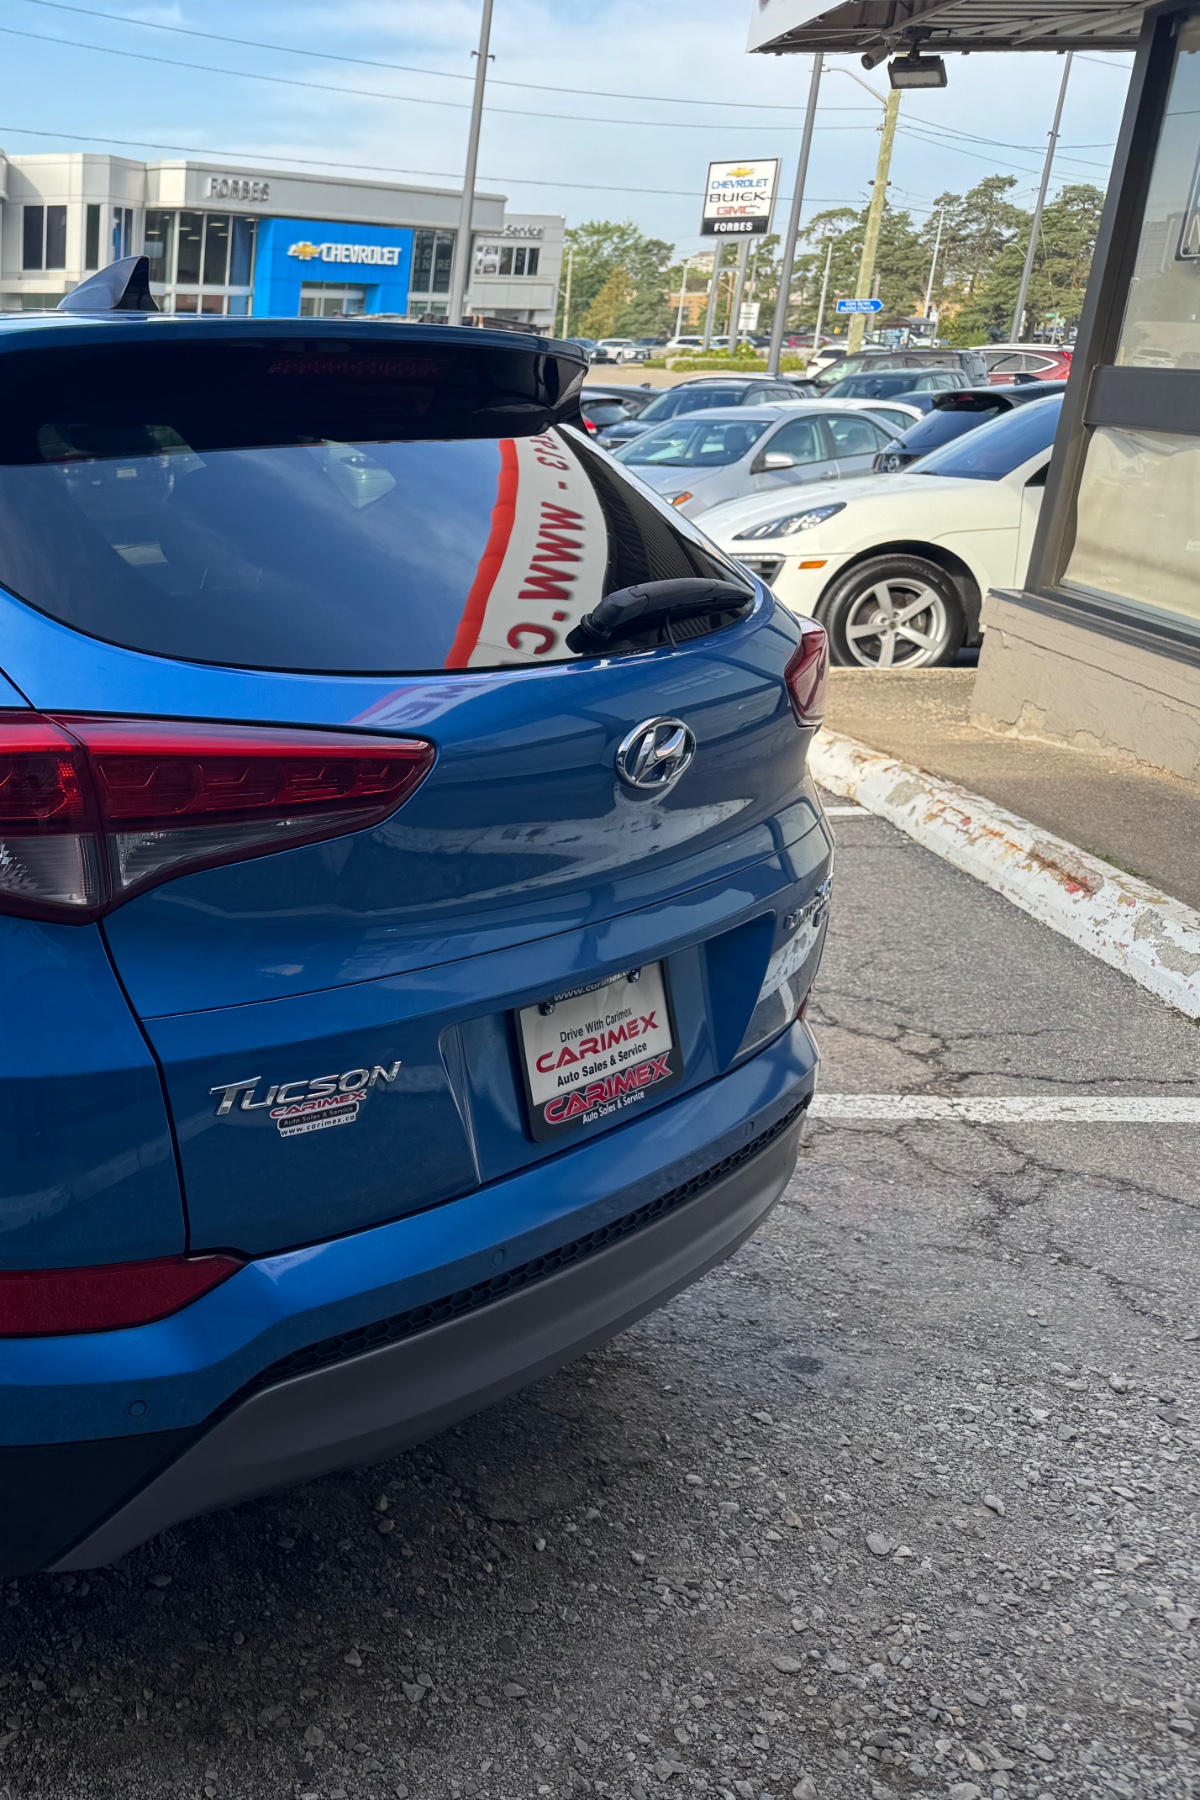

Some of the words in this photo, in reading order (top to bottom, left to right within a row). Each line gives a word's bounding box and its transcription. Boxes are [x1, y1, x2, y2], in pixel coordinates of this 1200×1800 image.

[205, 178, 271, 202] FORBES
[711, 178, 769, 190] CHEVROLET
[708, 191, 768, 203] BUICK
[716, 205, 756, 216] GMC
[503, 223, 544, 238] Service
[713, 221, 754, 233] FORBES
[319, 243, 402, 266] CHEVROLET
[560, 1027, 584, 1043] Drive
[585, 1018, 604, 1034] With
[605, 1007, 633, 1026] Carimex
[535, 1010, 660, 1074] CARIMEX
[557, 1071, 580, 1087] Auto
[581, 1060, 608, 1077] Sales
[609, 1054, 617, 1067] &
[618, 1042, 647, 1062] Service
[208, 1060, 402, 1116] TUCSON
[544, 1052, 673, 1124] CARIMEX
[270, 1089, 367, 1118] CARIMEX
[582, 1111, 598, 1124] Auto
[599, 1104, 616, 1117] Sales
[617, 1099, 623, 1109] &
[623, 1090, 645, 1106] Service
[281, 1115, 356, 1136] www.carimex.ca
[283, 1117, 301, 1126] Auto
[302, 1113, 320, 1122] Sales
[329, 1106, 354, 1116] Service
